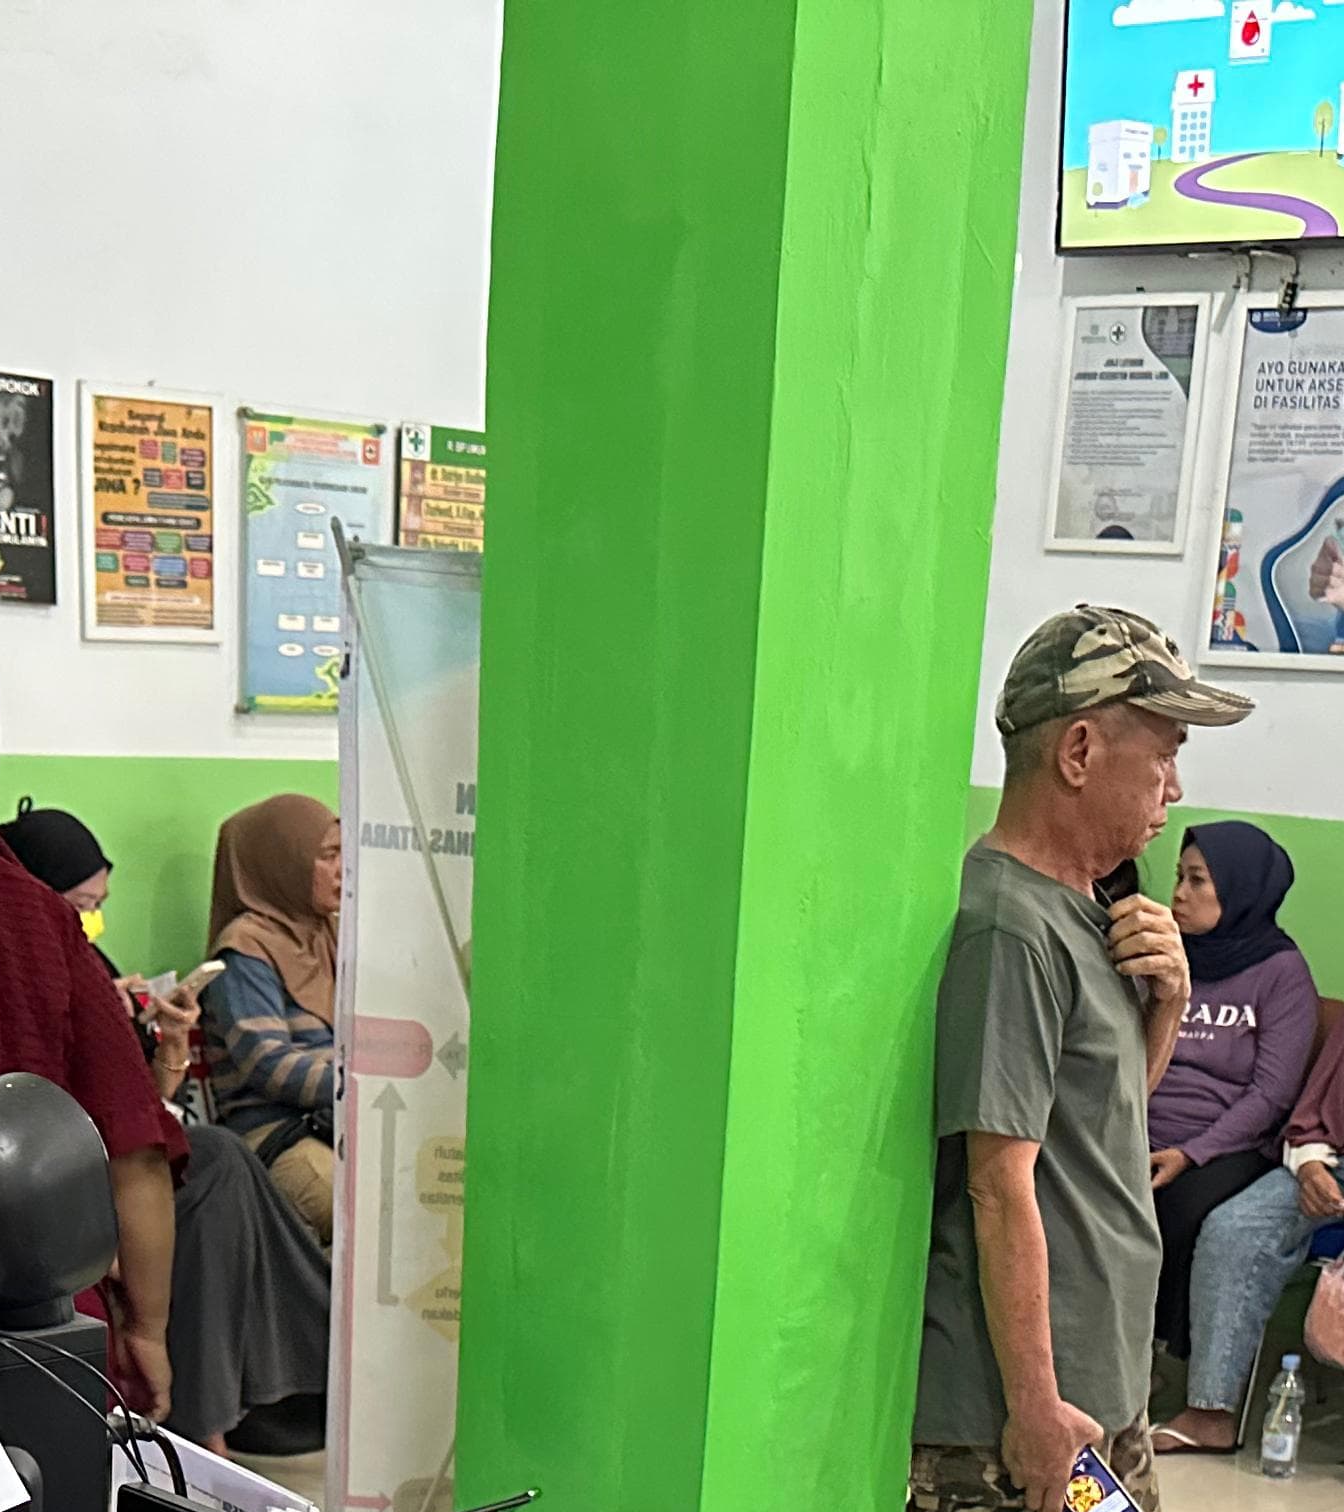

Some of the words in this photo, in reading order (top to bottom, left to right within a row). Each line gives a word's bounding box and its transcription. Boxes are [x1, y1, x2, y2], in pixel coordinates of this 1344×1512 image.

[1257, 361, 1284, 375] AYO
[1256, 379, 1305, 392] UNTUK
[1253, 395, 1267, 409] DI
[1271, 395, 1340, 409] FASILITAS
